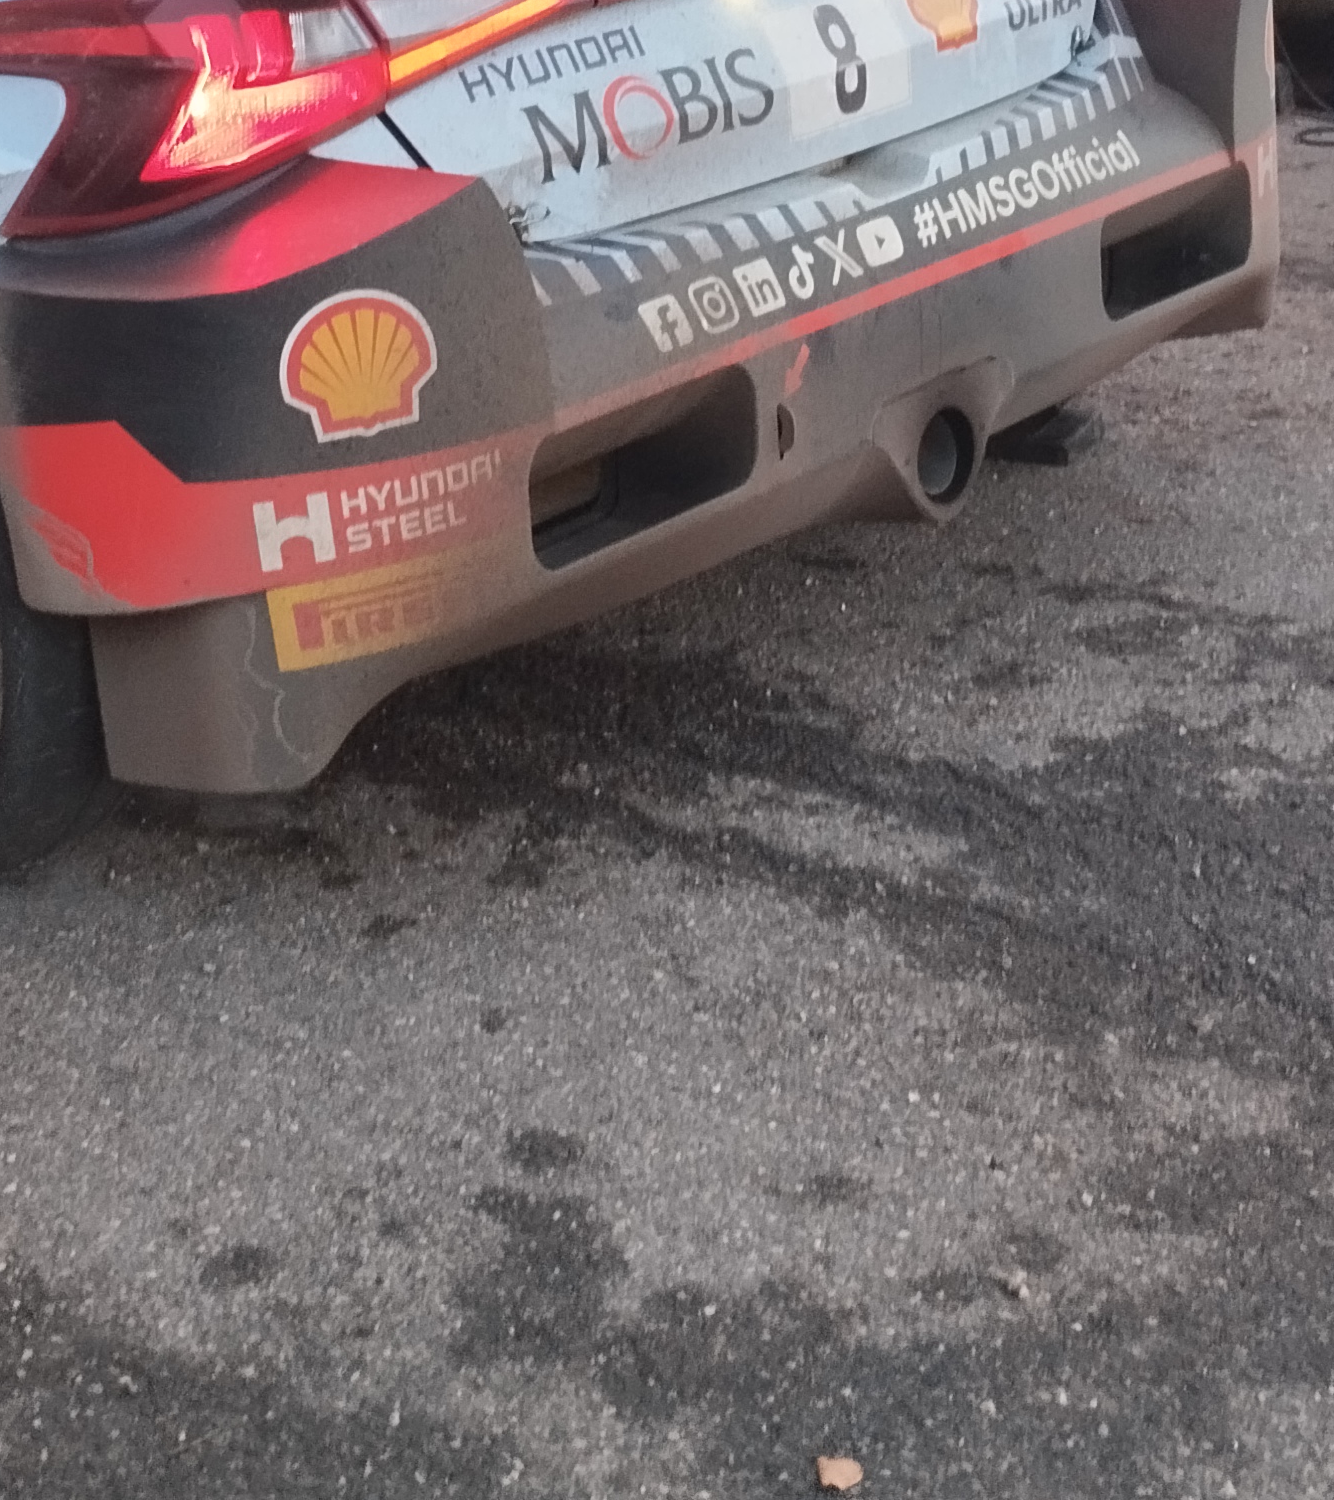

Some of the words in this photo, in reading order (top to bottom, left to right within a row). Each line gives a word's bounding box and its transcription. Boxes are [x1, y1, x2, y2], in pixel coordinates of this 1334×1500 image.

[457, 24, 647, 104] HYUNDAI
[812, 3, 867, 114] 8
[519, 47, 776, 185] MOBIS
[913, 129, 1142, 249] #HMSGOfficial
[339, 448, 503, 520] HYUNDAI
[345, 499, 468, 554] STEEL
